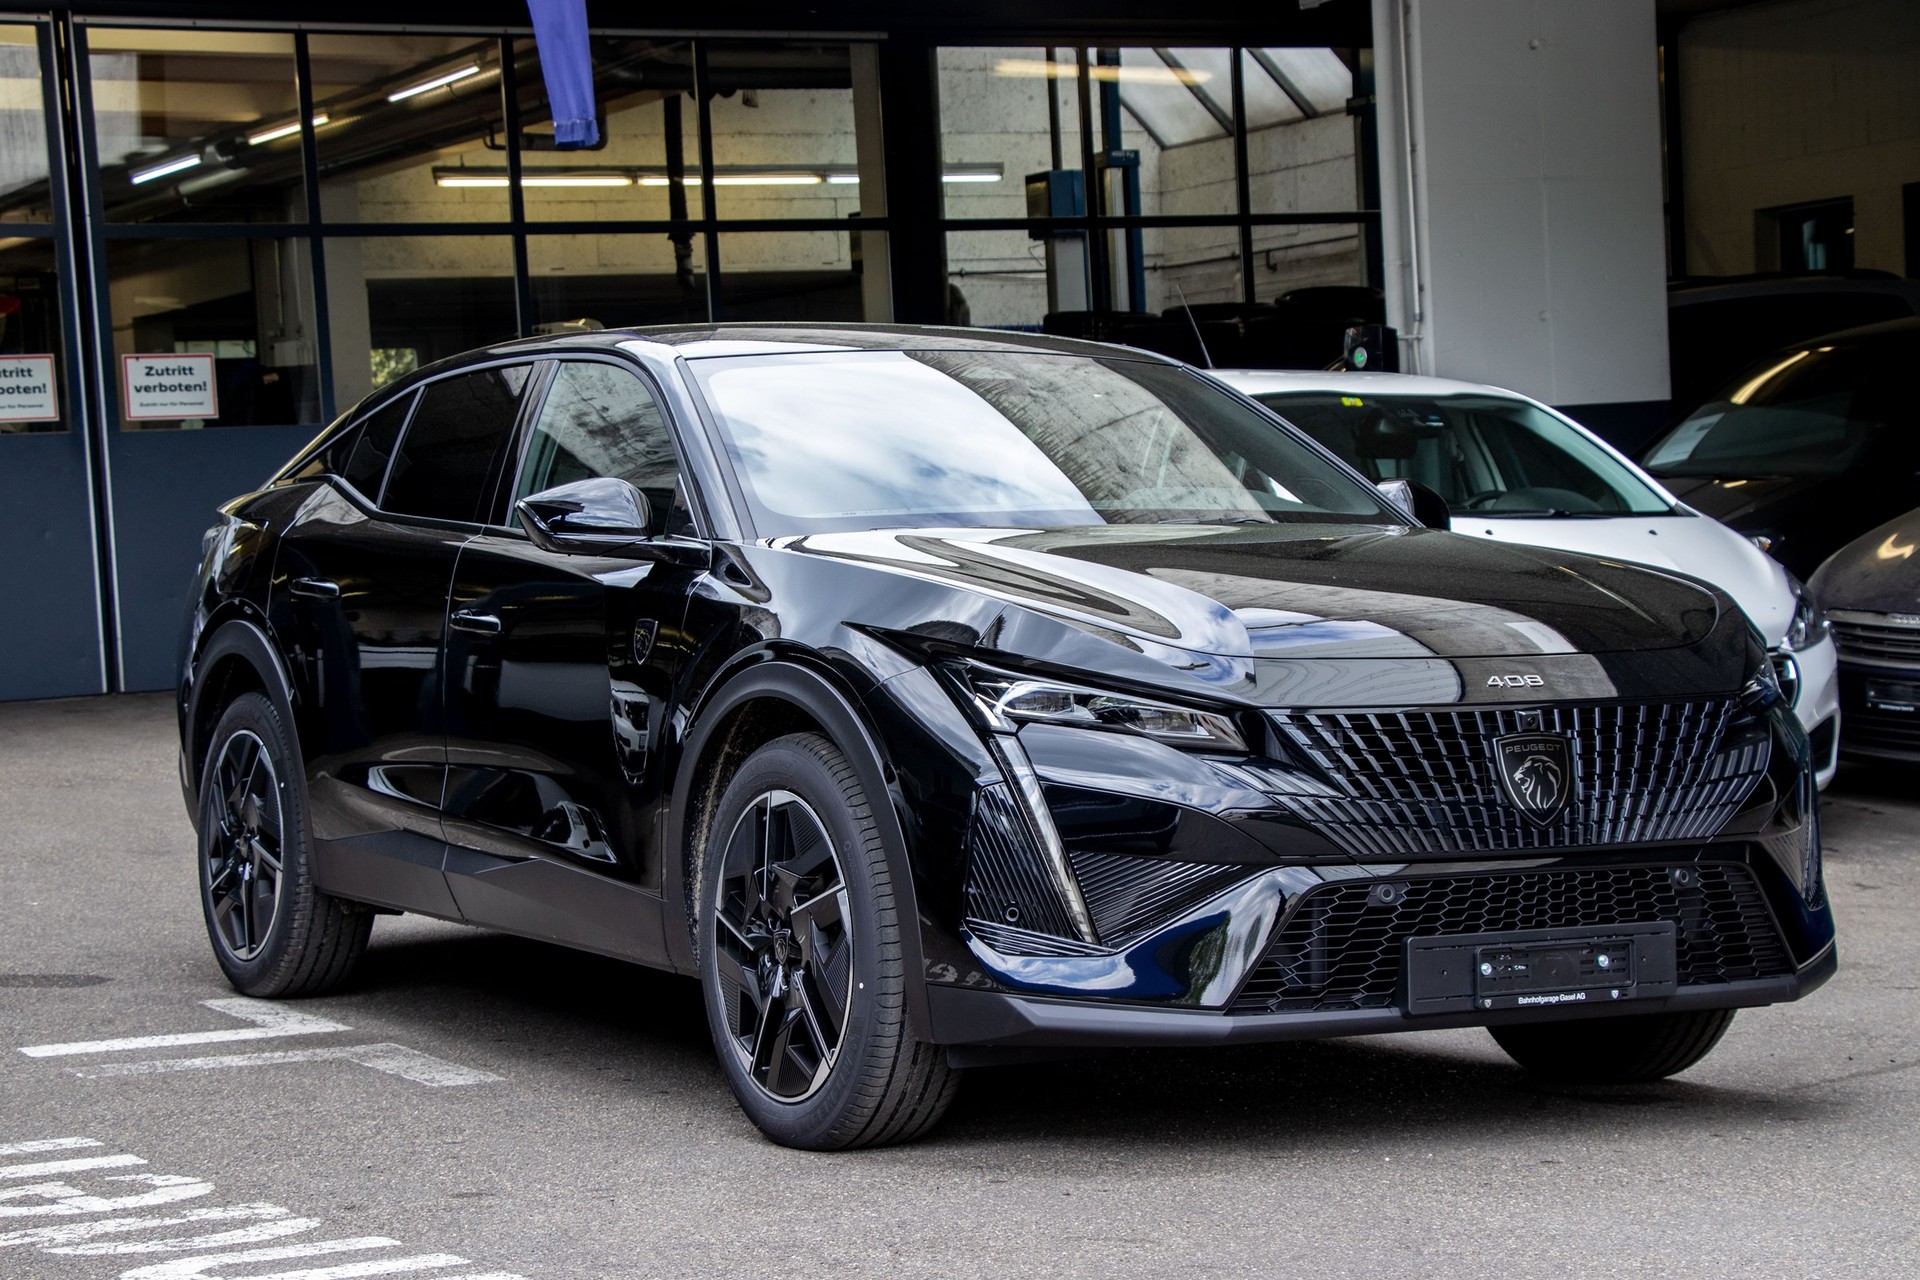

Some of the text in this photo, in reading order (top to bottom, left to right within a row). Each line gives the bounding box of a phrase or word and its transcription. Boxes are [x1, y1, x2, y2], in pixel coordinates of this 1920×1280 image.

[0, 366, 34, 378] tritt
[144, 365, 195, 377] Zutritt
[134, 381, 207, 393] verboten!
[1487, 674, 1545, 688] 408
[1505, 743, 1562, 754] PEUGEOT
[1576, 992, 1586, 1000] AG
